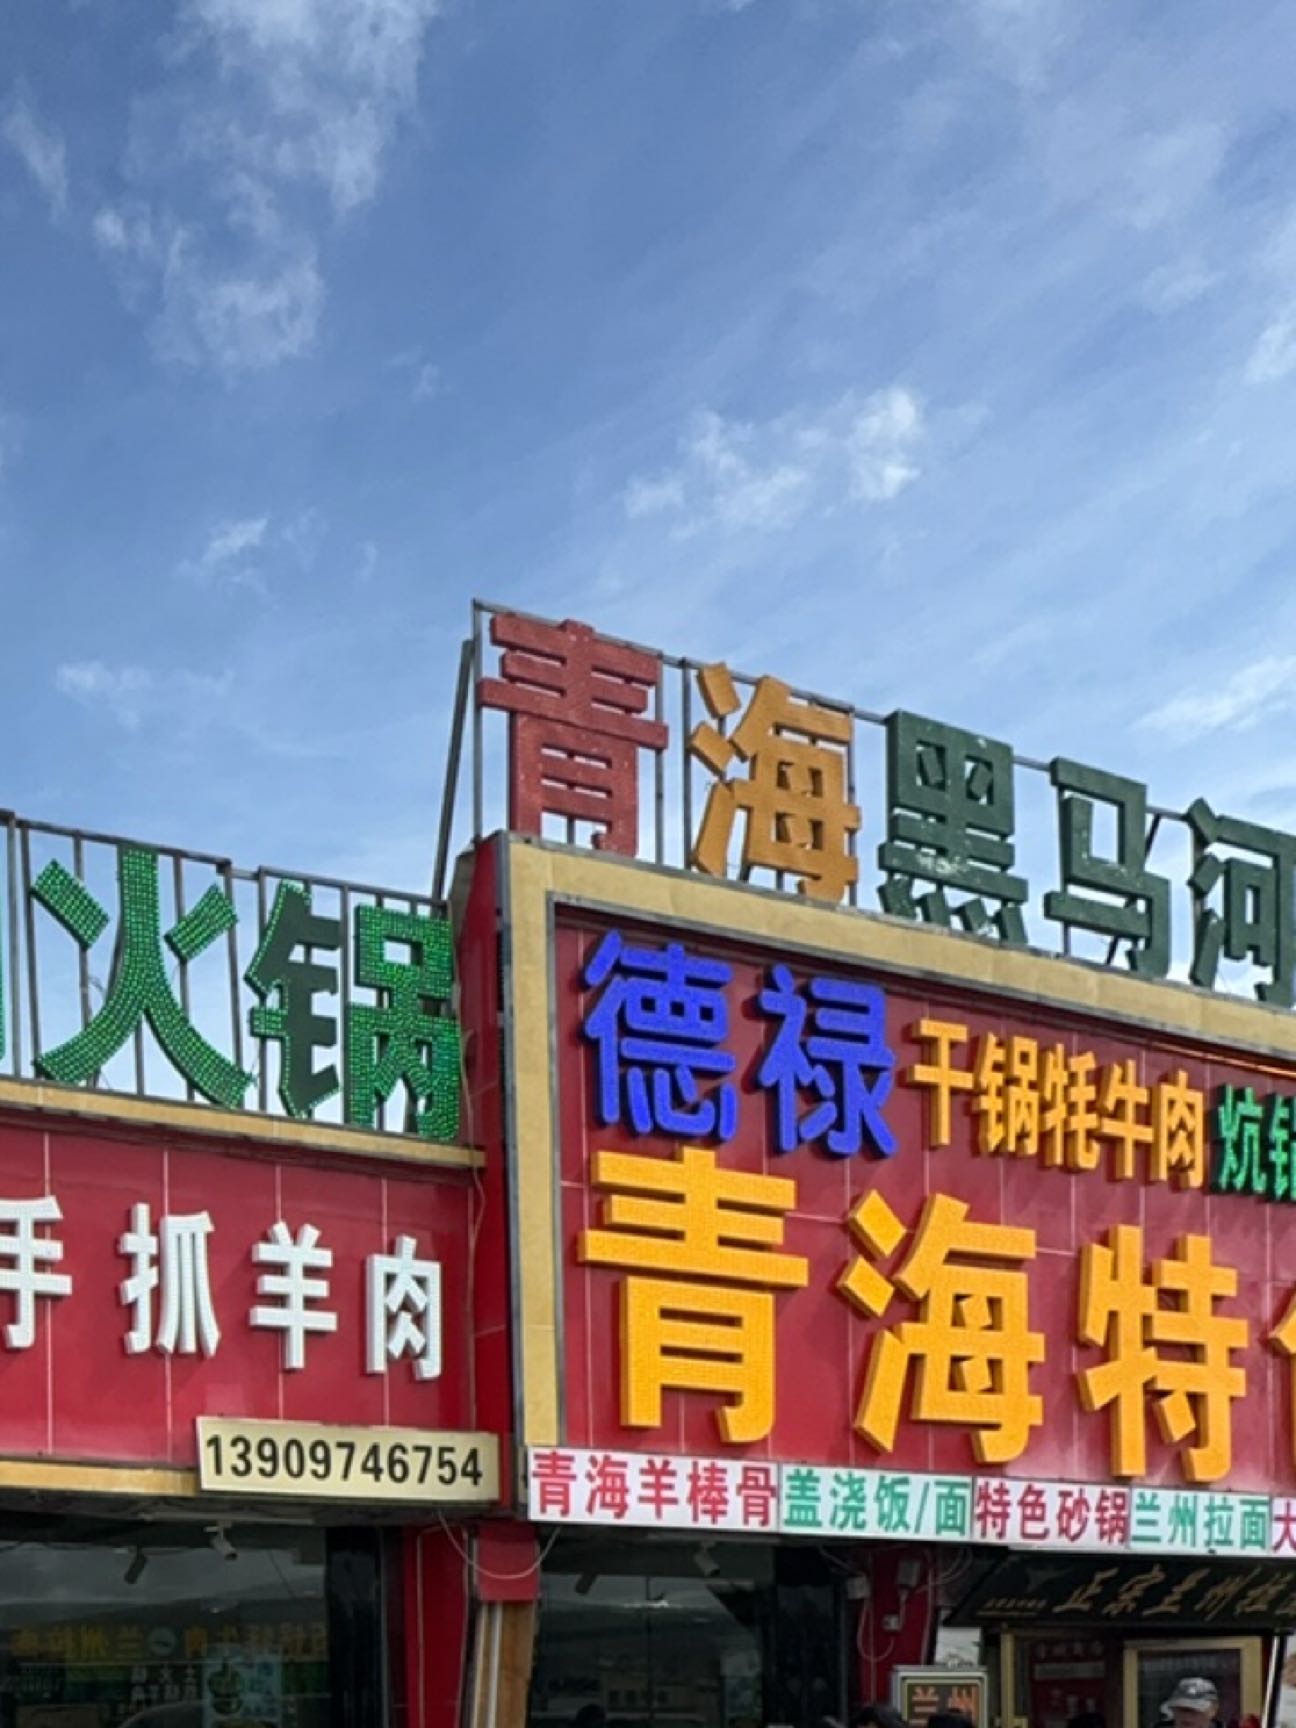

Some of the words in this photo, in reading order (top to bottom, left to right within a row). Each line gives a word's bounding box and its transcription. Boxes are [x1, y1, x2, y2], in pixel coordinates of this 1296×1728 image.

[478, 613, 1296, 1010] 青海黑马河
[582, 929, 896, 1158] 德禄
[910, 1019, 1205, 1192] 干锅牦牛肉
[577, 1146, 1296, 1485] 青海特
[206, 1434, 483, 1487] 13909746754
[532, 1451, 777, 1528] 青海羊棒骨
[782, 1467, 972, 1538] 盖浇饭/面
[975, 1477, 1130, 1545] 特色砂锅
[1131, 1490, 1269, 1549] 兰州拉面
